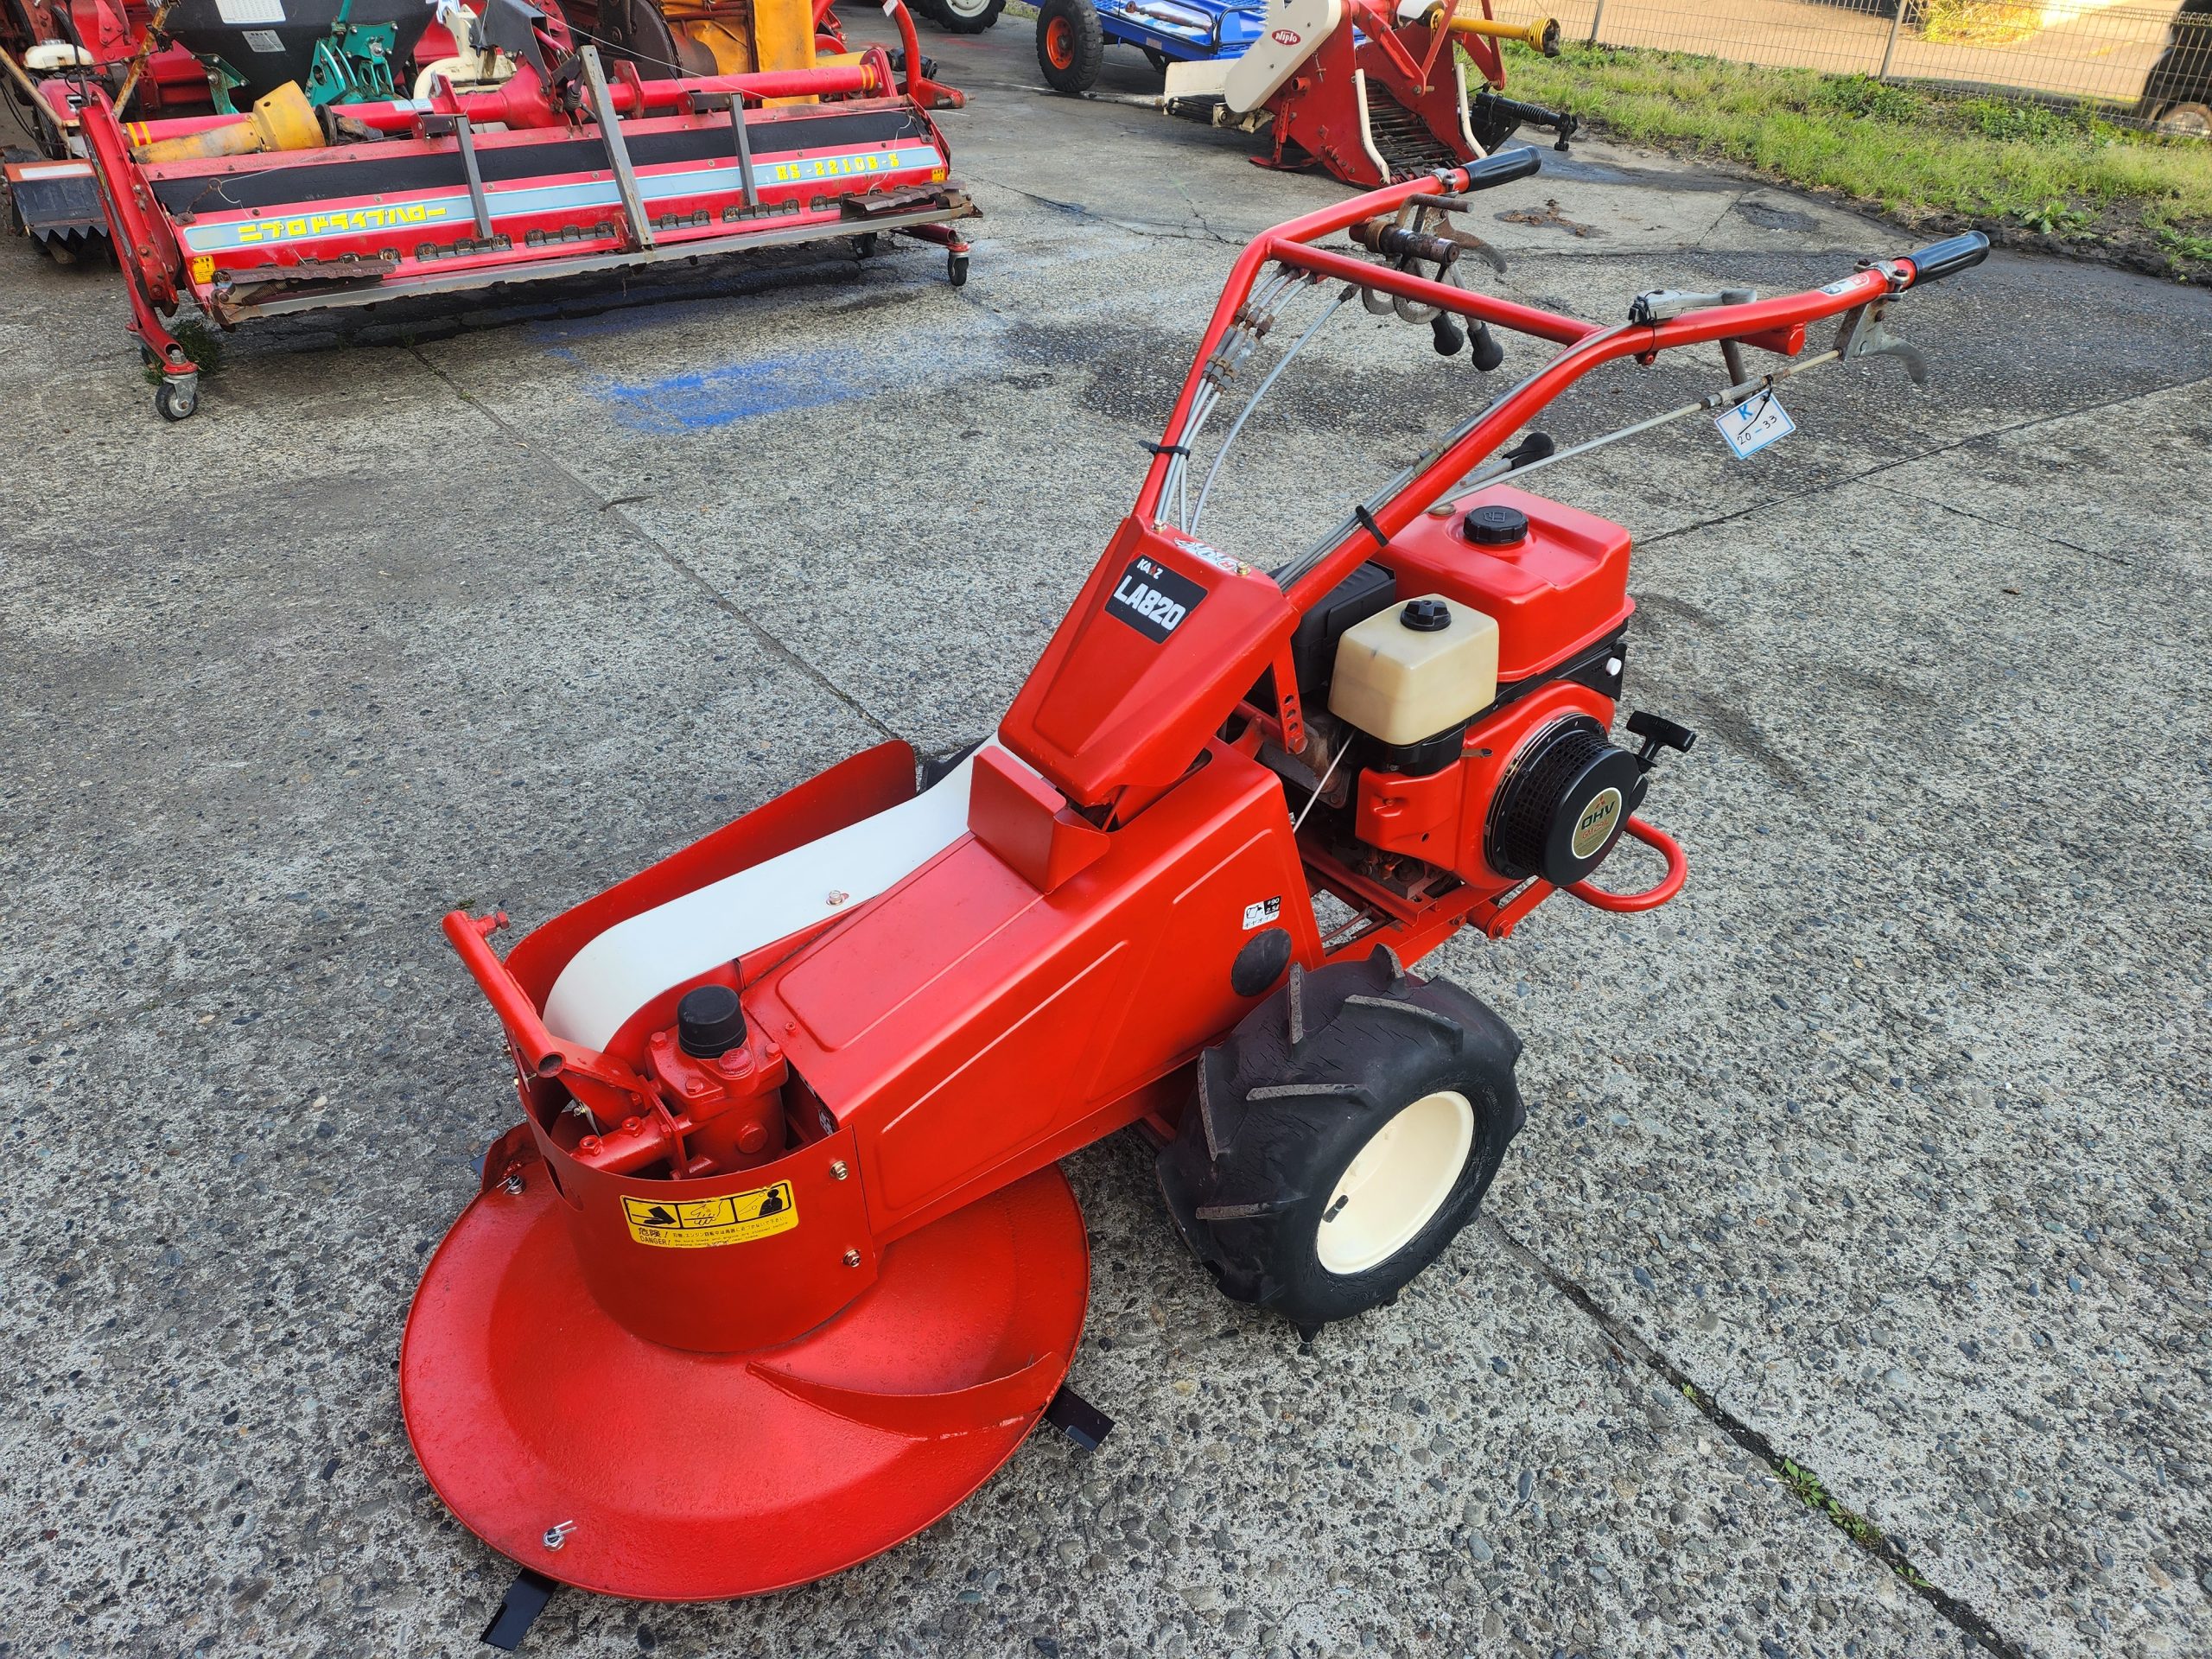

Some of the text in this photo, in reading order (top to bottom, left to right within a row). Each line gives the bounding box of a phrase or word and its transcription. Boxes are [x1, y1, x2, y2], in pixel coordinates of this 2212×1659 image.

[1274, 30, 1298, 44] Niplo
[238, 205, 447, 243] ニプロドライブハロー
[1738, 404, 1753, 420] K
[1113, 575, 1186, 631] LA820
[1580, 801, 1616, 830] OHV
